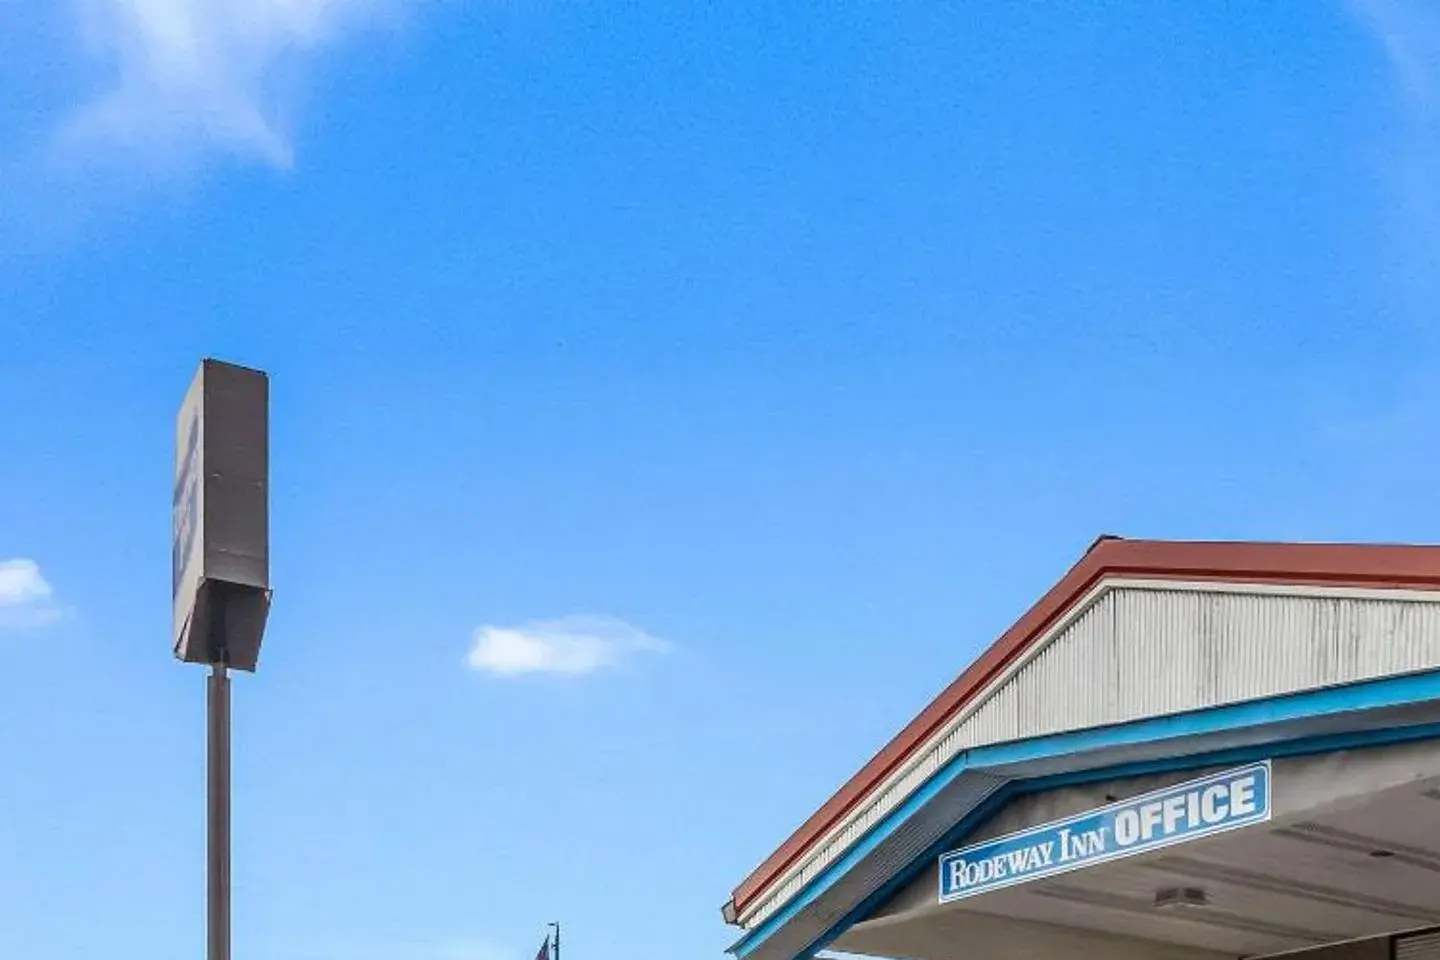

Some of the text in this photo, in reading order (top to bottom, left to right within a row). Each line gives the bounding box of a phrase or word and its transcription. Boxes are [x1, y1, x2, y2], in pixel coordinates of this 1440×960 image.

[950, 776, 1256, 890] RODEWAY INN OFFICE
